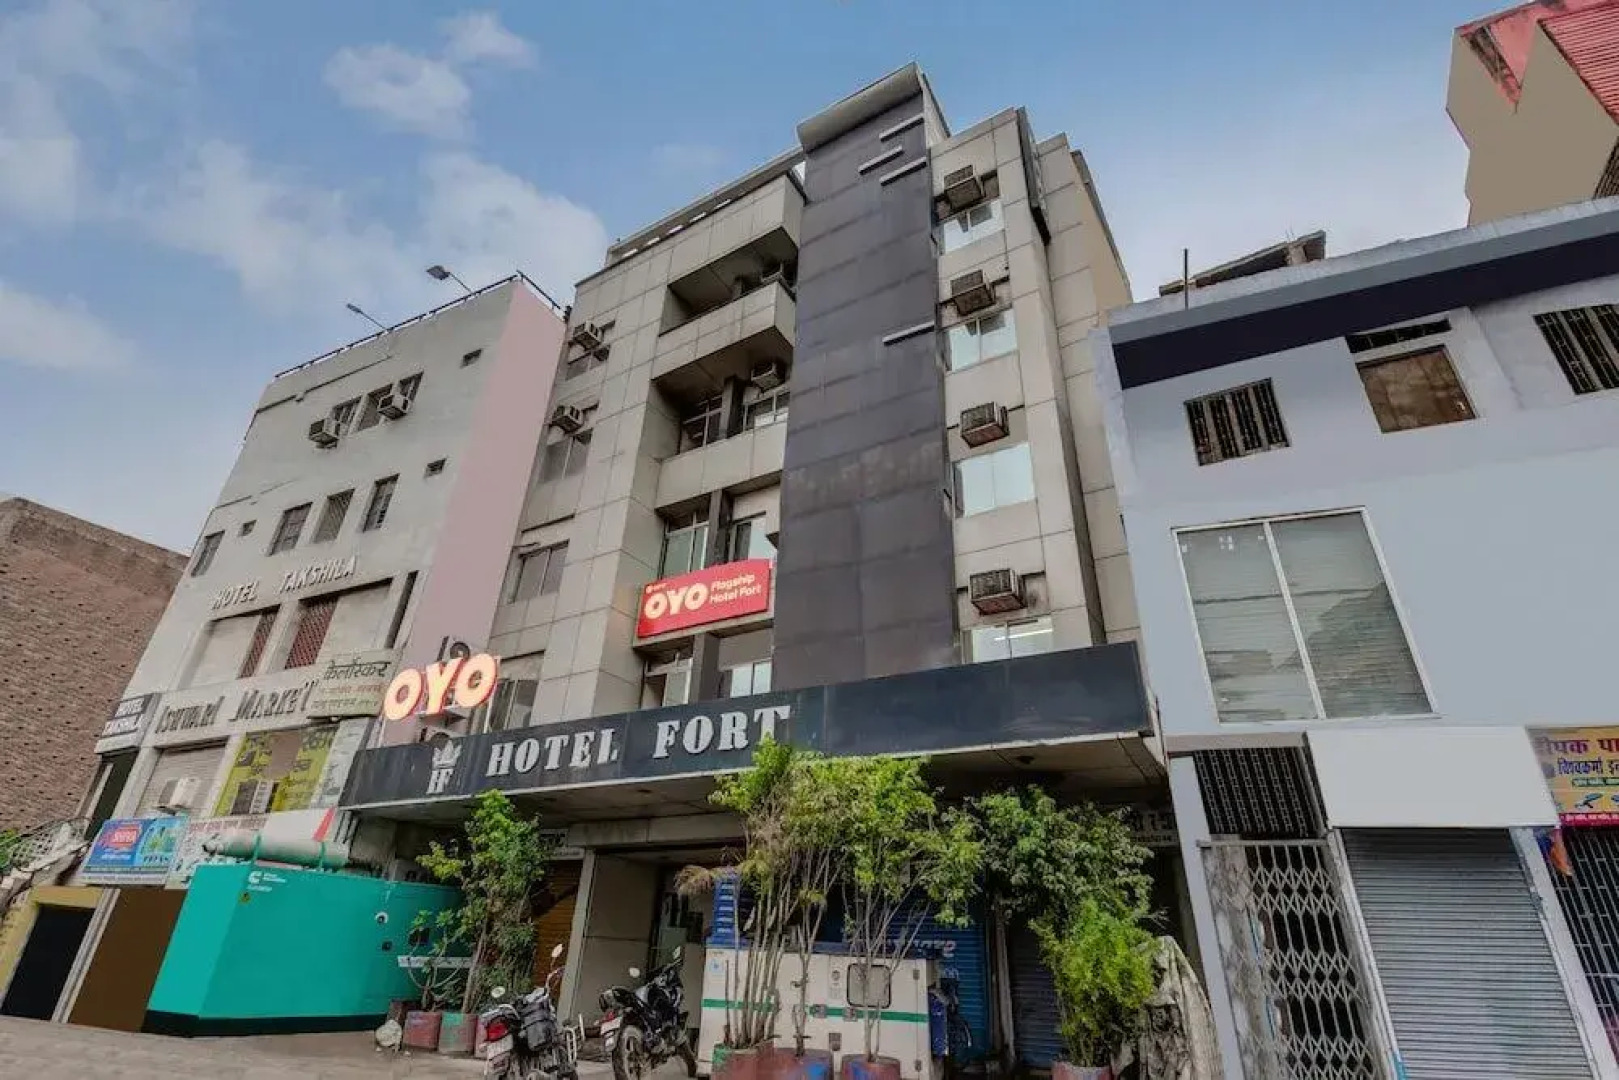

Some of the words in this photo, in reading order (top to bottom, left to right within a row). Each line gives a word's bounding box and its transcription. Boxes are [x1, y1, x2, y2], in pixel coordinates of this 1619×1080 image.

[211, 580, 259, 610] HOTEL
[710, 589, 738, 604] Hotel
[740, 584, 762, 597] Fort
[711, 574, 755, 591] Flagship
[644, 583, 708, 619] OYO
[384, 653, 500, 720] OYO
[486, 728, 619, 777] HOTEL
[653, 705, 791, 759] FORT
